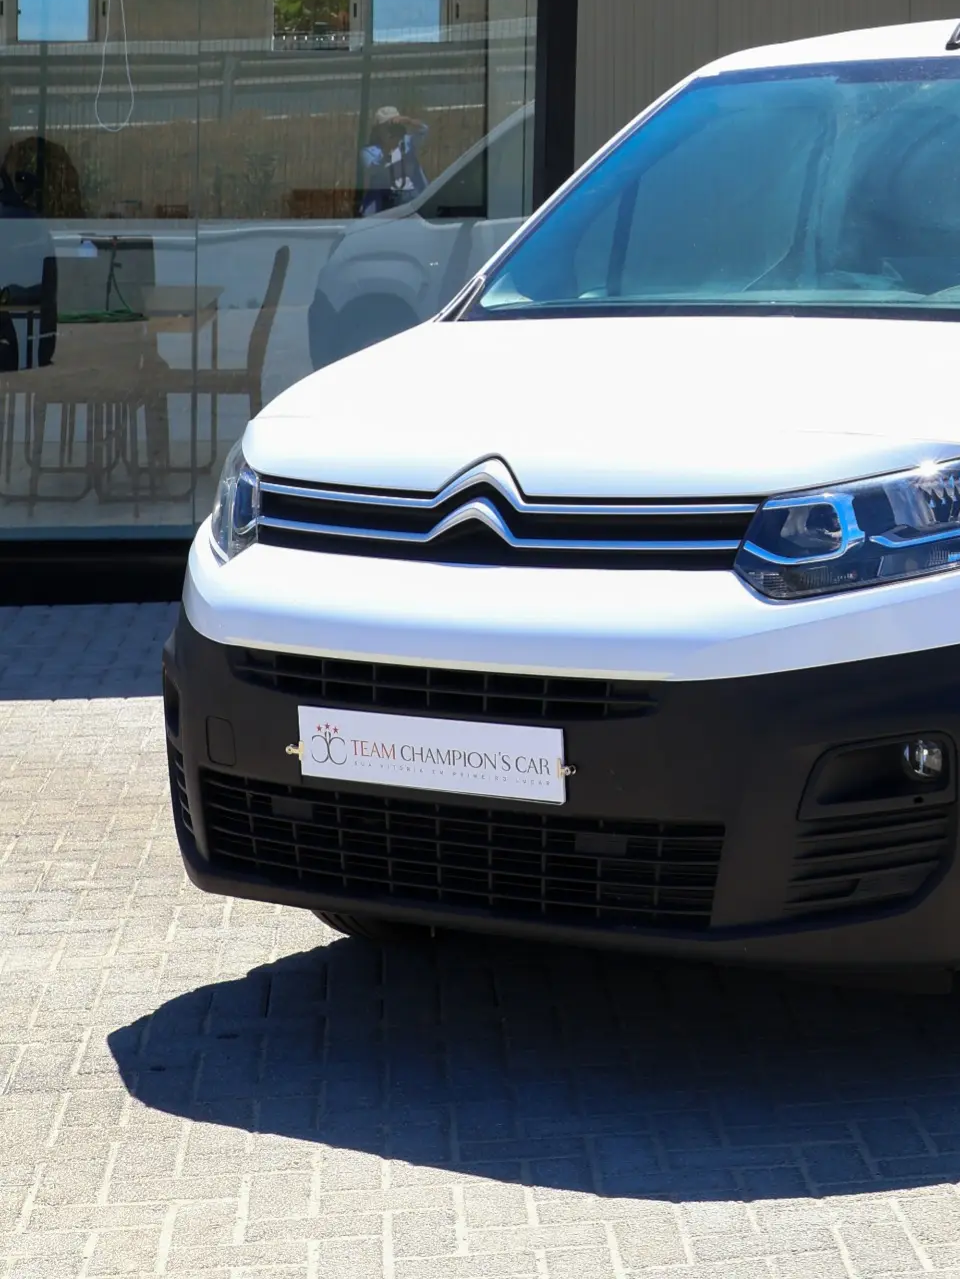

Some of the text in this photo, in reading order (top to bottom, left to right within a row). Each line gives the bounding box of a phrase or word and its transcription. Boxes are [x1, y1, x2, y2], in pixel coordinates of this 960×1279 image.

[351, 739, 551, 776] TEAM CHAMPION'S CAR
